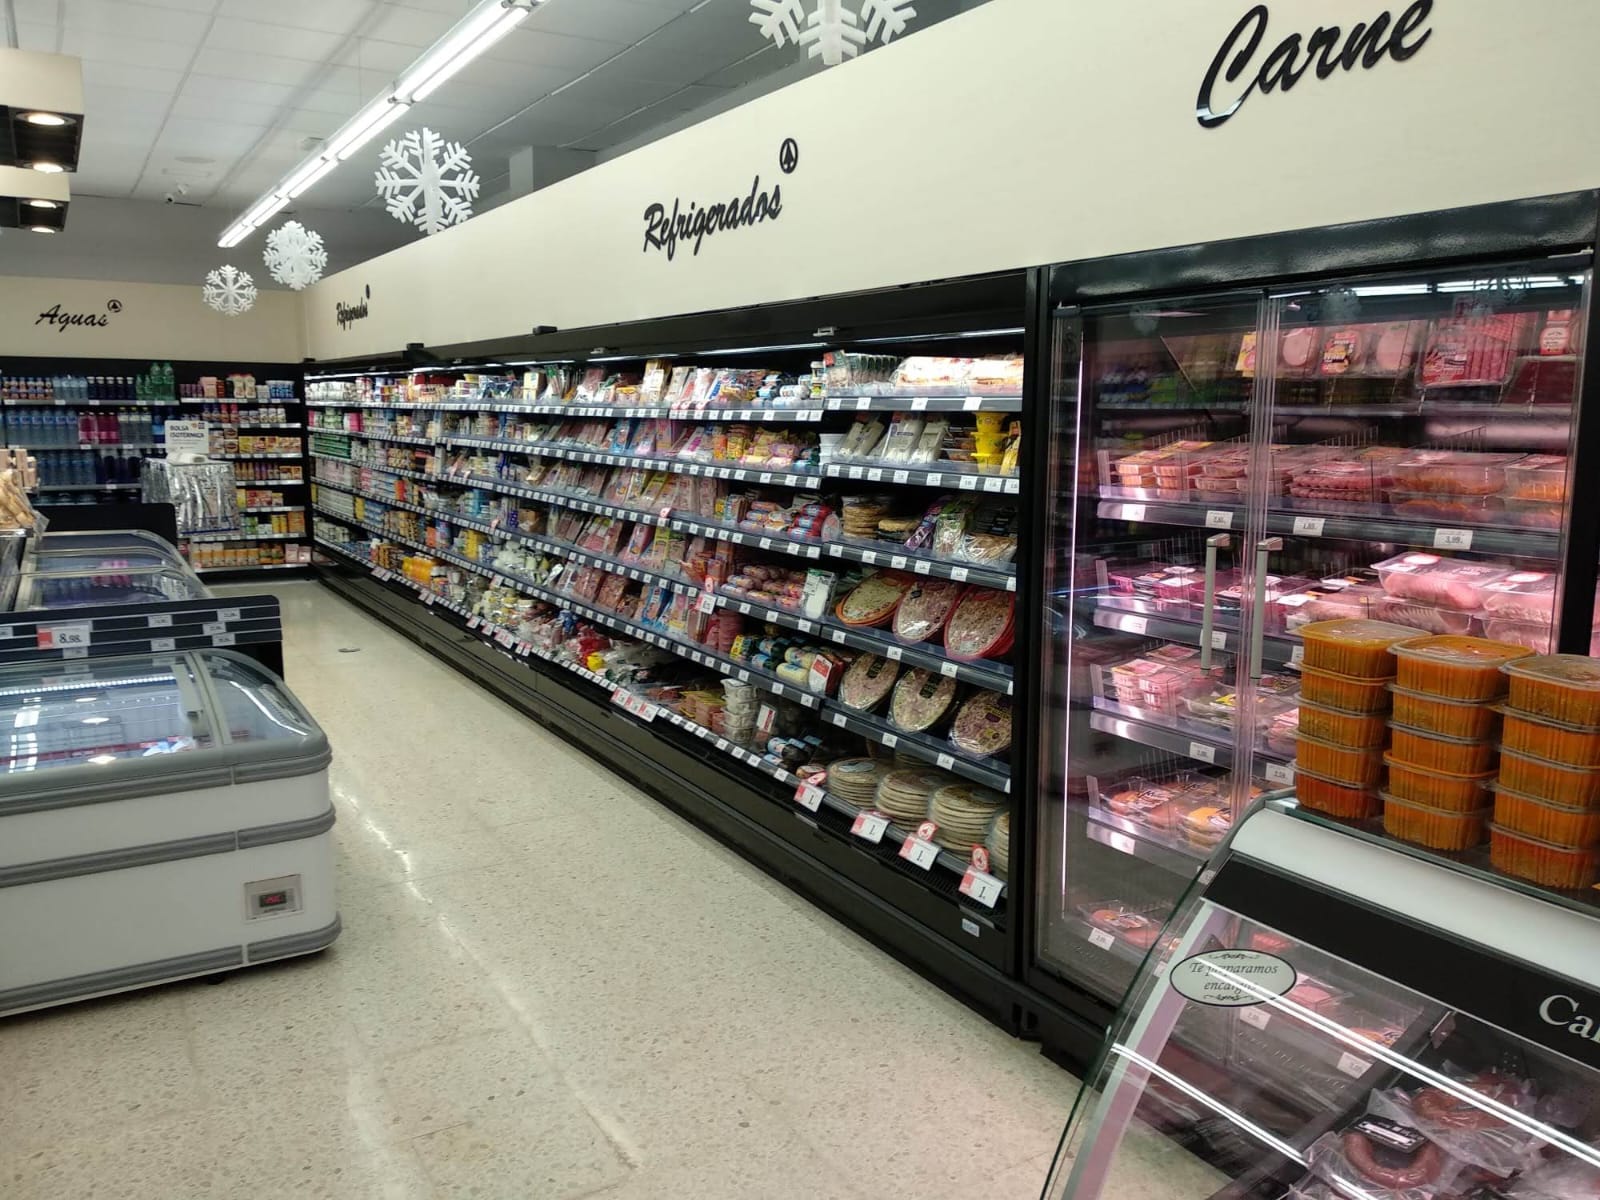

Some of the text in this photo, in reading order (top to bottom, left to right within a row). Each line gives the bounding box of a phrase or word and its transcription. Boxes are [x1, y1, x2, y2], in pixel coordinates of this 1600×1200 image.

[1196, 0, 1434, 128] Carne
[643, 174, 783, 262] Refrigerados
[35, 304, 109, 332] Aguas
[1189, 962, 1203, 974] Te
